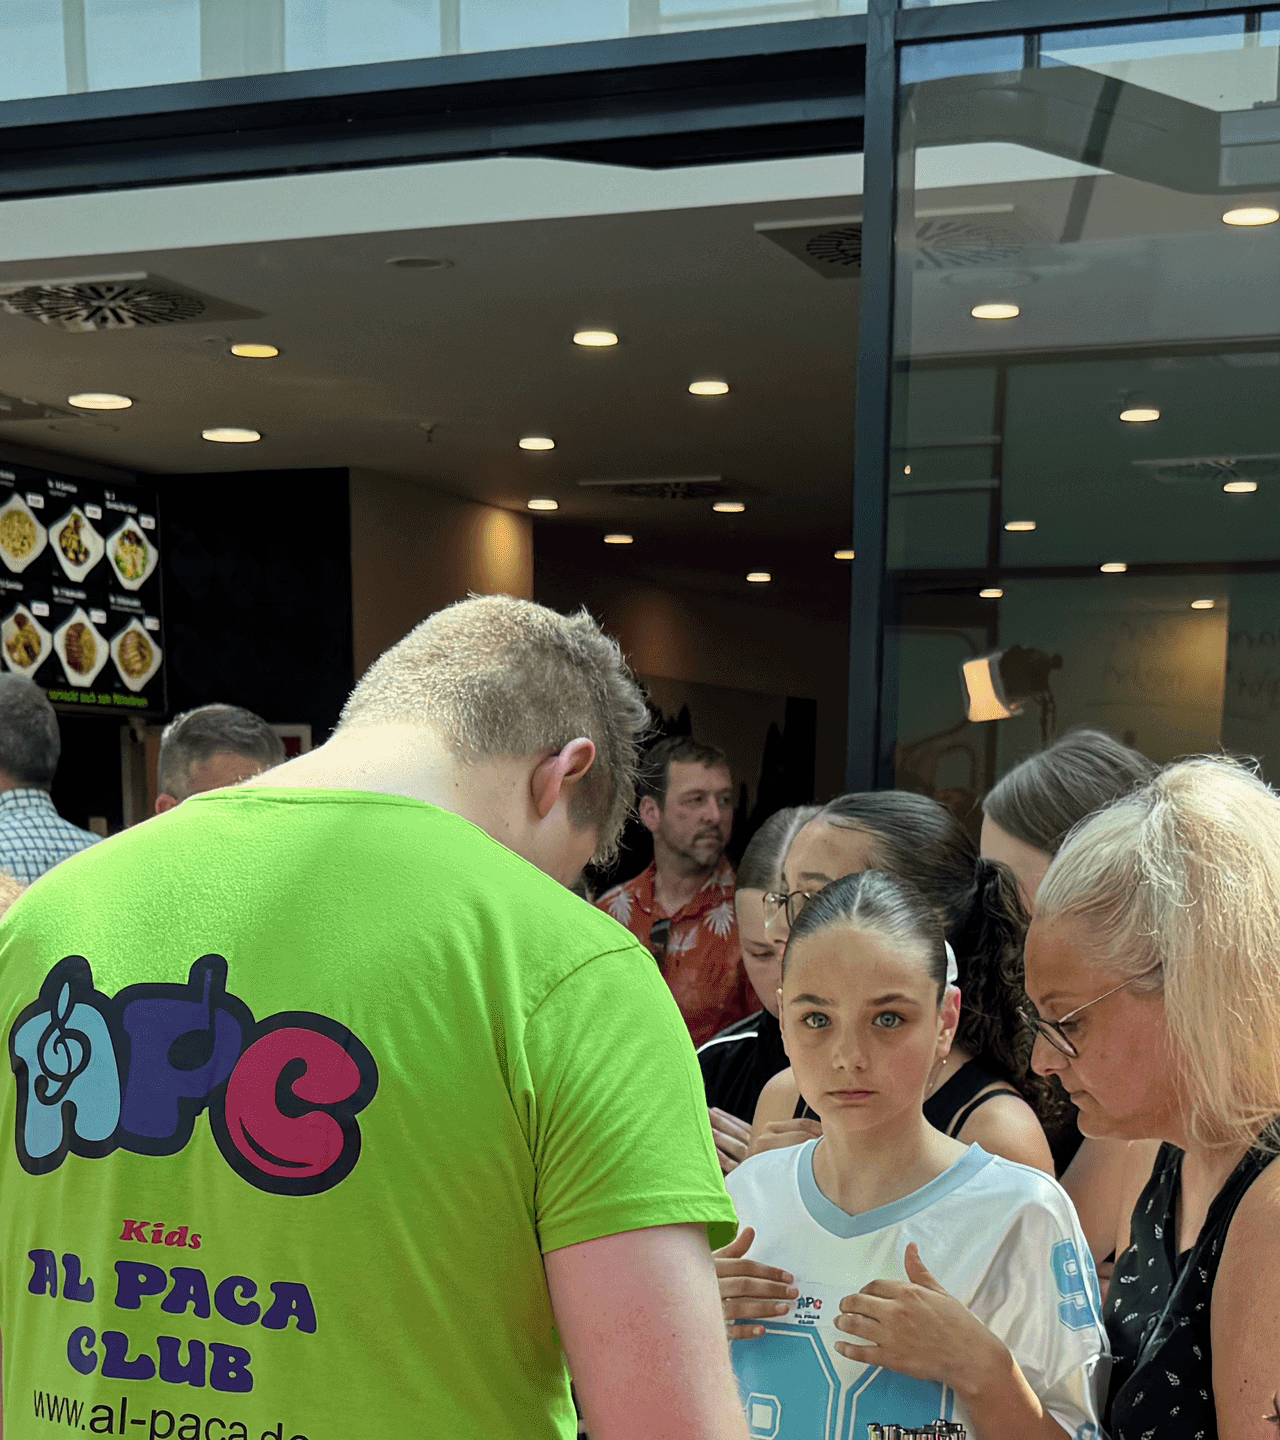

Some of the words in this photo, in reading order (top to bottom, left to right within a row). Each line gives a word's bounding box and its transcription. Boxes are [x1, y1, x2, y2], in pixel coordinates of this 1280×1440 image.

[9, 954, 378, 1196] APC
[119, 1219, 202, 1250] Kids
[28, 1249, 95, 1302] AL
[114, 1260, 317, 1334] PACA
[67, 1327, 254, 1393] CLUB
